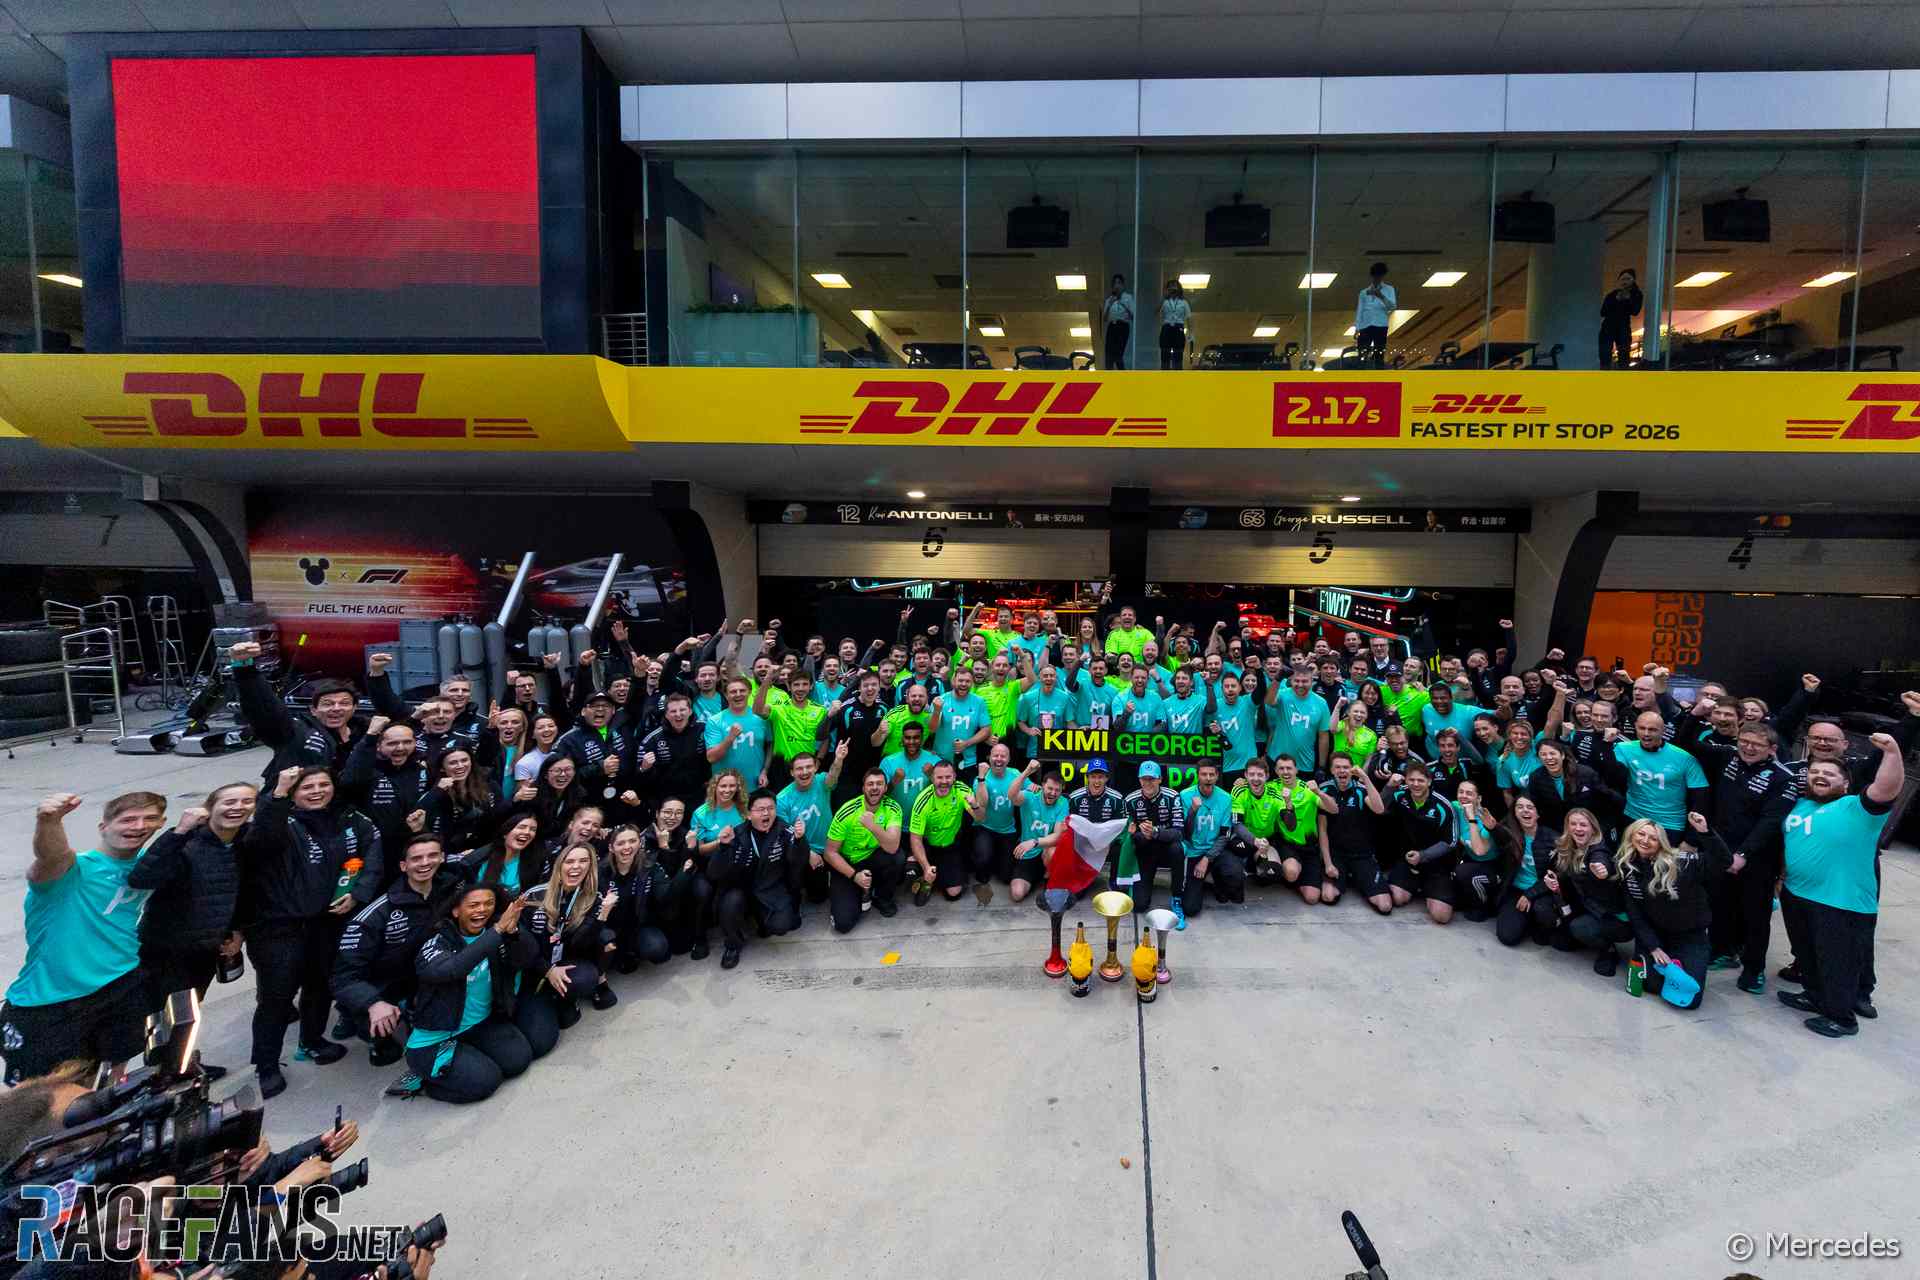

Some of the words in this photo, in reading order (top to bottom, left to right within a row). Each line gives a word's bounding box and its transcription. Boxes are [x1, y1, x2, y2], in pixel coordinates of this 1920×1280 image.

[123, 372, 467, 438] DHL
[847, 380, 1119, 436] DHL
[1287, 396, 1380, 425] 2.17s
[1431, 393, 1530, 414] DHL
[1410, 422, 1508, 439] FASTEST
[1513, 423, 1551, 439] PIT
[1555, 423, 1614, 440] STOP
[1624, 424, 1681, 441] 2026
[837, 503, 861, 524] 12
[887, 510, 994, 521] ANTONELLI
[1239, 508, 1266, 528] 63
[1311, 513, 1413, 525] RUSSELL
[921, 526, 949, 559] 6
[1307, 530, 1337, 565] 5
[1726, 533, 1756, 571] 4
[308, 603, 339, 614] FUEL
[341, 604, 365, 614] THE
[366, 604, 407, 615] MAGIC
[952, 714, 970, 731] P1
[1132, 711, 1149, 726] P1
[1290, 711, 1311, 729] P1
[732, 730, 755, 750] P1
[1043, 729, 1109, 752] KIMI
[1115, 733, 1222, 758] GEORGE
[903, 777, 924, 794] P1
[1635, 769, 1666, 790] P1
[1197, 814, 1215, 831] P1
[1785, 814, 1814, 836] P1
